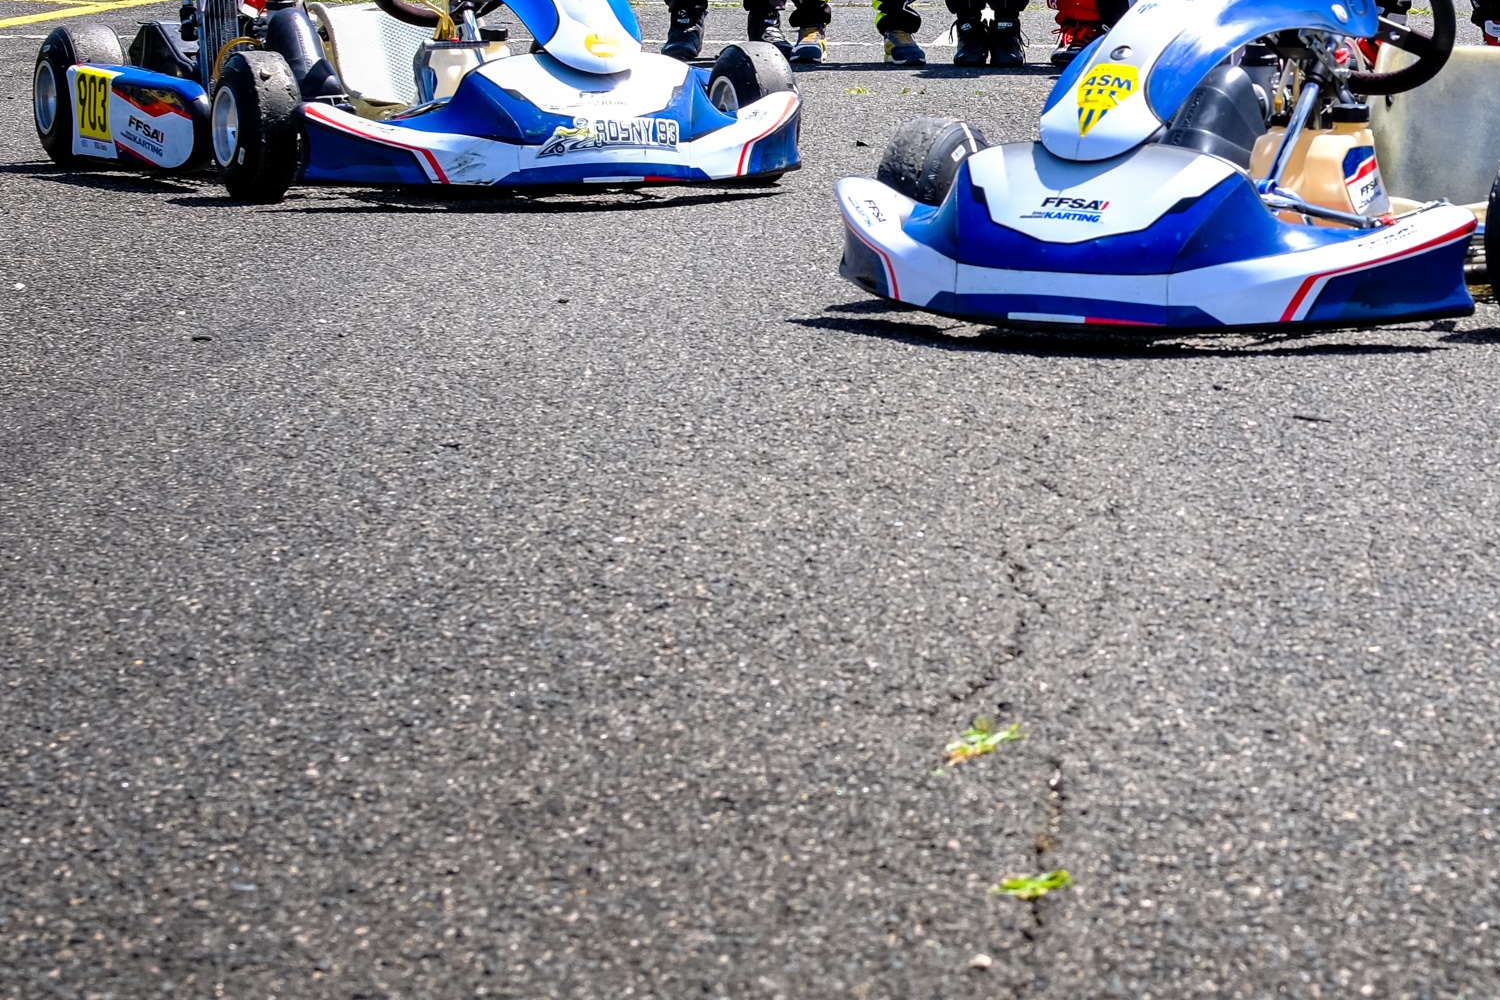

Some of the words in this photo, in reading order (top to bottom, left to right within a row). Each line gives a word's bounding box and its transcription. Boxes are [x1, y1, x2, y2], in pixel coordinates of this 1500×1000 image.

[1081, 73, 1132, 92] ASM
[77, 73, 108, 134] 903
[128, 114, 162, 142] FFSA
[595, 119, 653, 144] ROSNY
[658, 120, 678, 146] 93
[131, 135, 164, 157] KARTING
[1041, 197, 1100, 211] FFSA
[1043, 211, 1101, 223] KARTING
